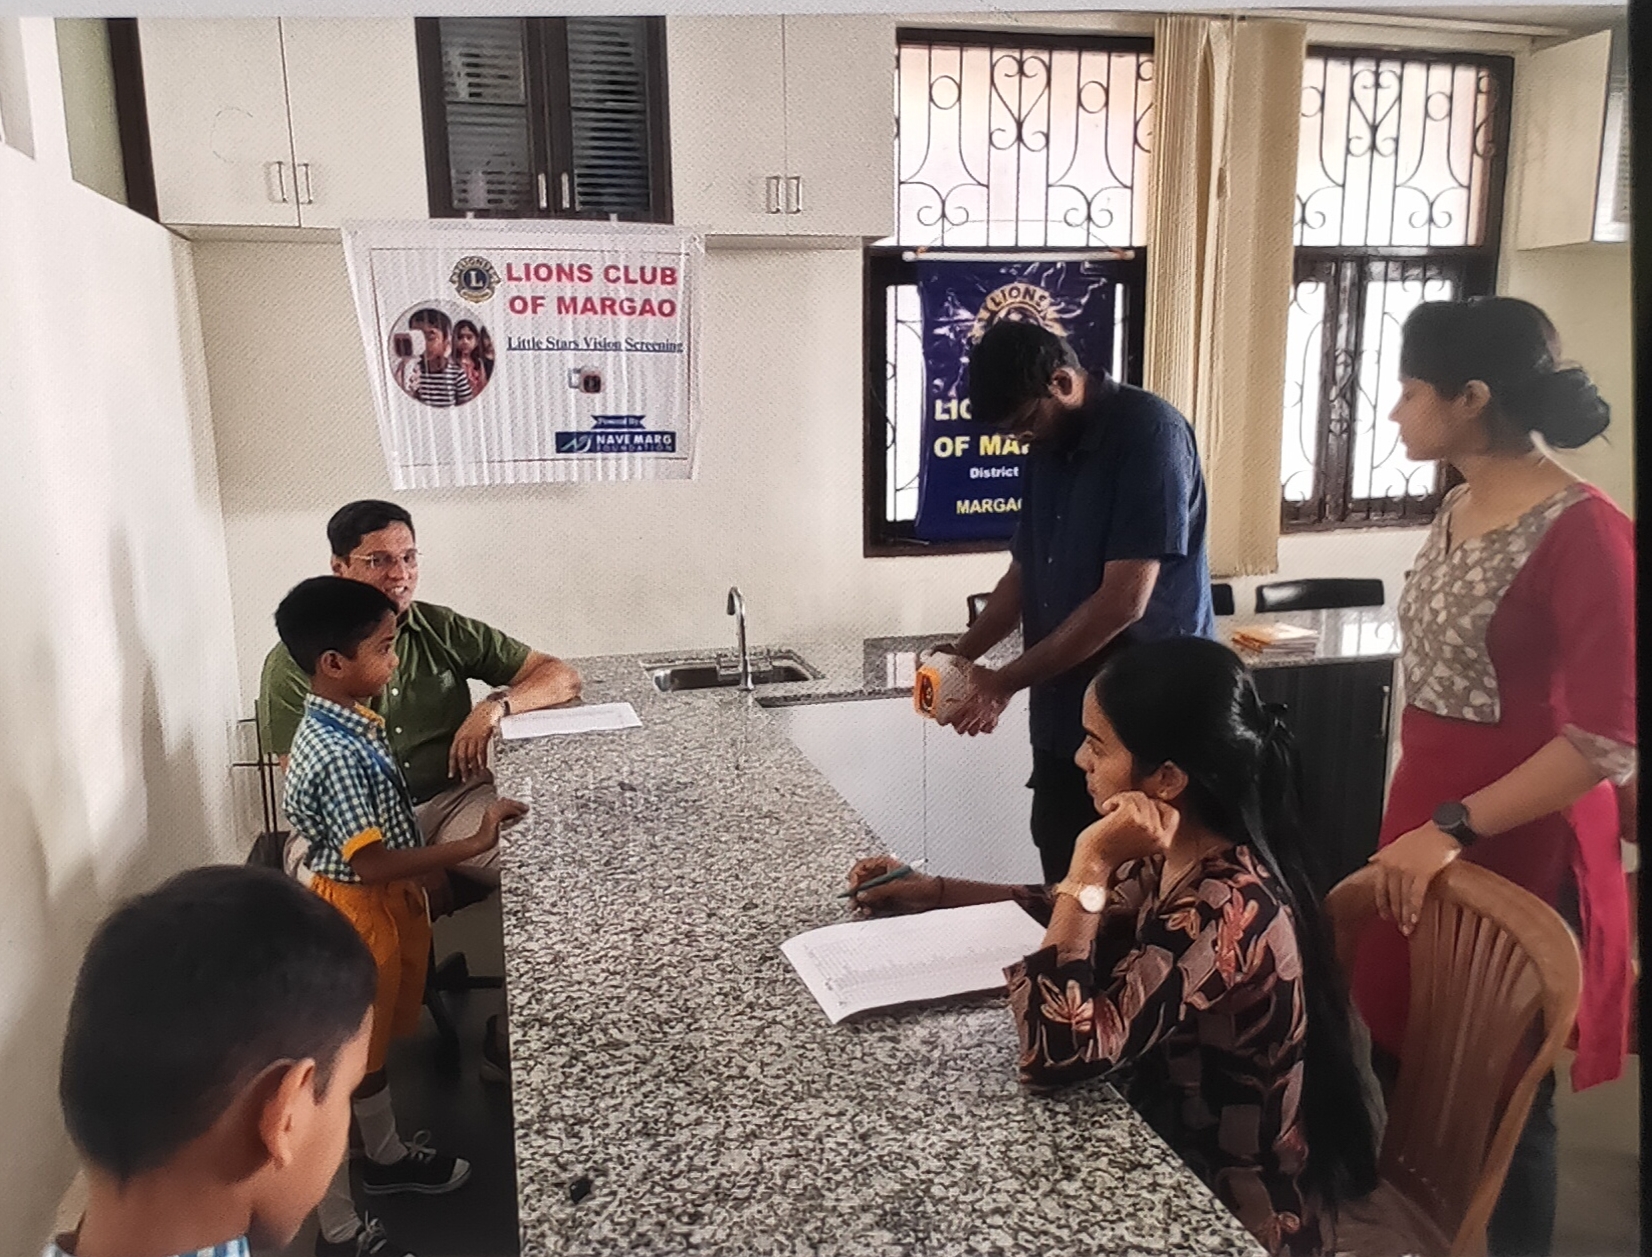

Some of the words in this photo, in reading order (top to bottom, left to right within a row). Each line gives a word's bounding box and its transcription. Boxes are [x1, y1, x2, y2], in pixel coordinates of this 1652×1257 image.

[469, 270, 484, 287] L
[506, 262, 594, 283] LIONS
[603, 264, 678, 286] CLUB
[508, 295, 546, 315] OF
[556, 296, 677, 317] MARGAO
[990, 286, 1047, 307] LIONS
[507, 336, 543, 350] Little
[545, 337, 580, 350] Stars
[583, 337, 622, 350] Vision
[624, 338, 684, 353] Screening
[934, 398, 972, 421] LIO
[596, 434, 630, 445] NAVE
[633, 434, 673, 445] MARG
[933, 435, 971, 458] OF
[969, 466, 1019, 479] District
